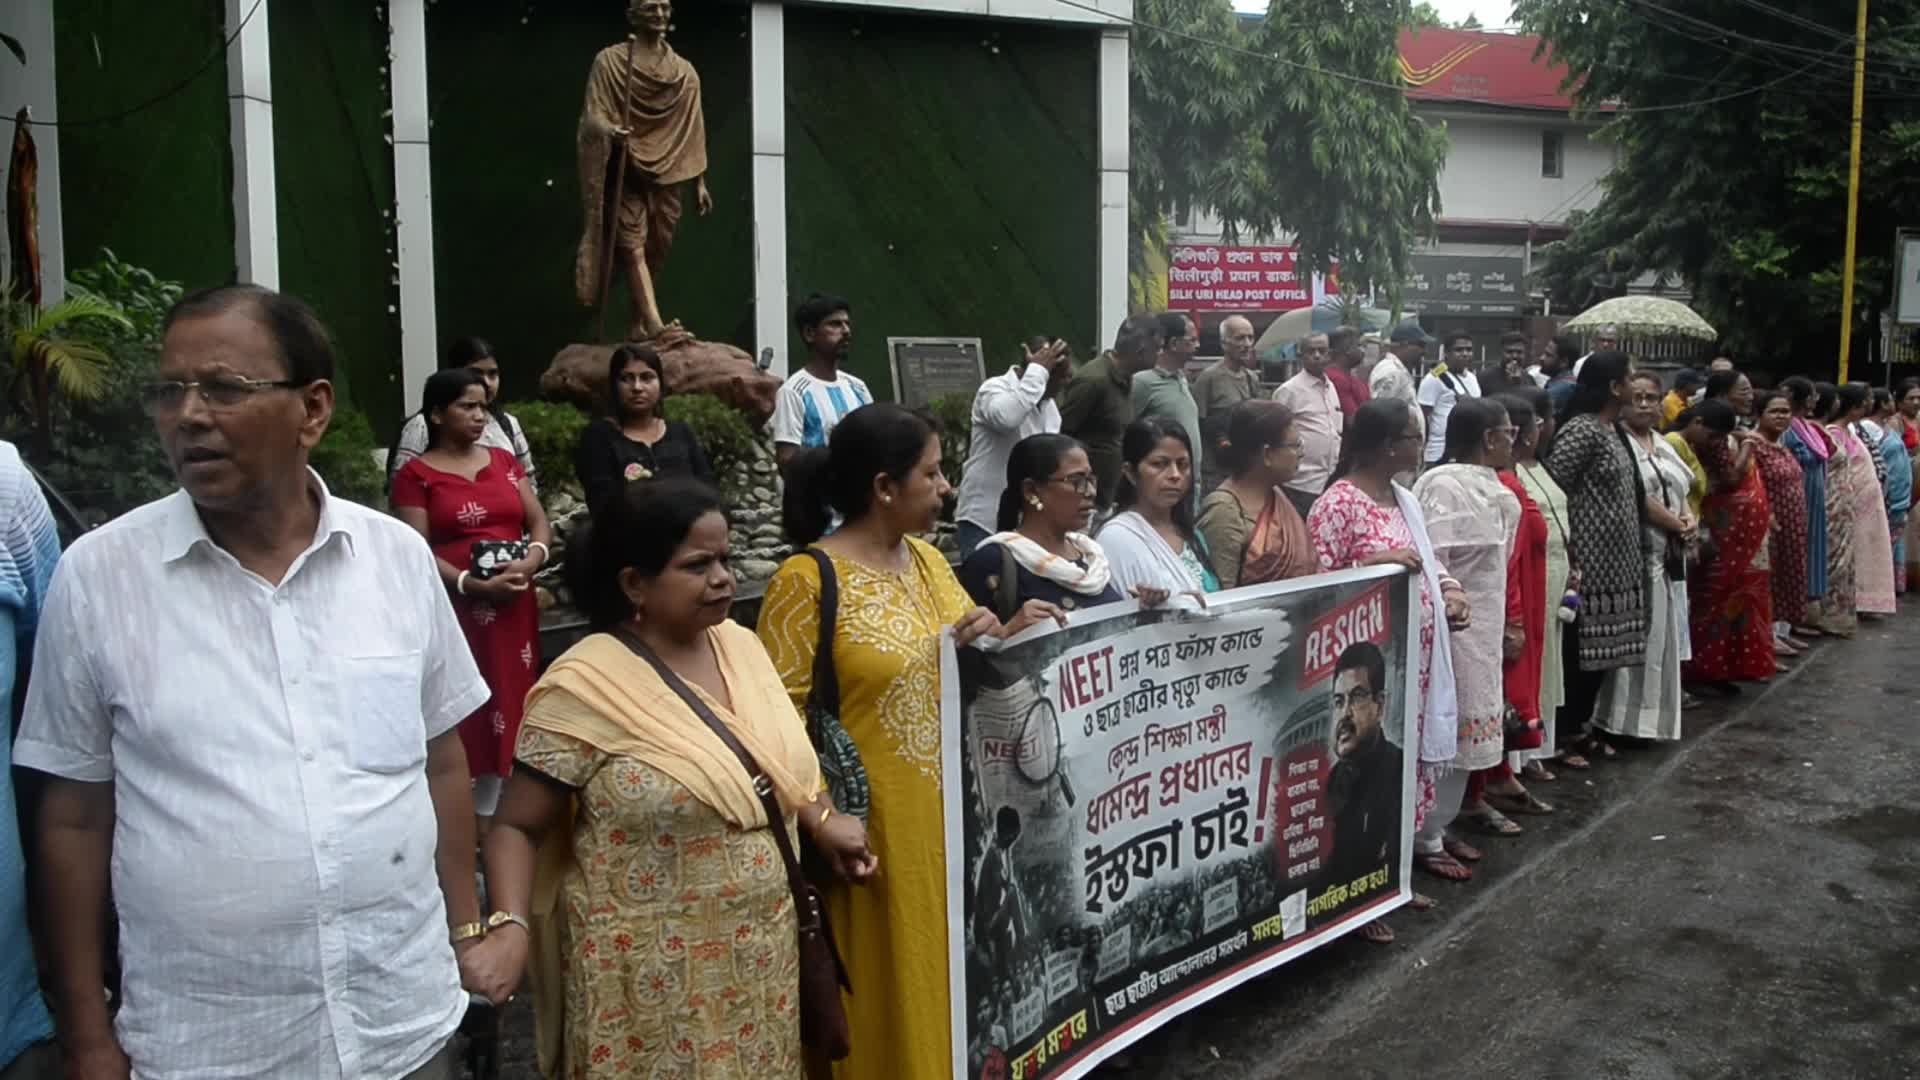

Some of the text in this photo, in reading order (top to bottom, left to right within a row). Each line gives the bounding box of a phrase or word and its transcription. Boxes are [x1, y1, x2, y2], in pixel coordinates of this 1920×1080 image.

[1215, 289, 1243, 300] HEAD
[1245, 289, 1271, 300] POST
[1273, 289, 1308, 300] OFFICE
[1304, 592, 1384, 671] RESIGN
[1059, 645, 1114, 713] NEET
[1145, 643, 1171, 668] পত্র
[1175, 633, 1218, 661] ফাঁস
[1083, 713, 1094, 737] ও
[1096, 701, 1121, 731] ছাত্র
[1123, 678, 1168, 718] ছাত্রীর
[1144, 723, 1192, 757] শিক্ষা
[1196, 704, 1227, 743] মন্ত্রী
[1159, 742, 1253, 807] প্রধানের
[1084, 818, 1183, 913] ইস্তফা
